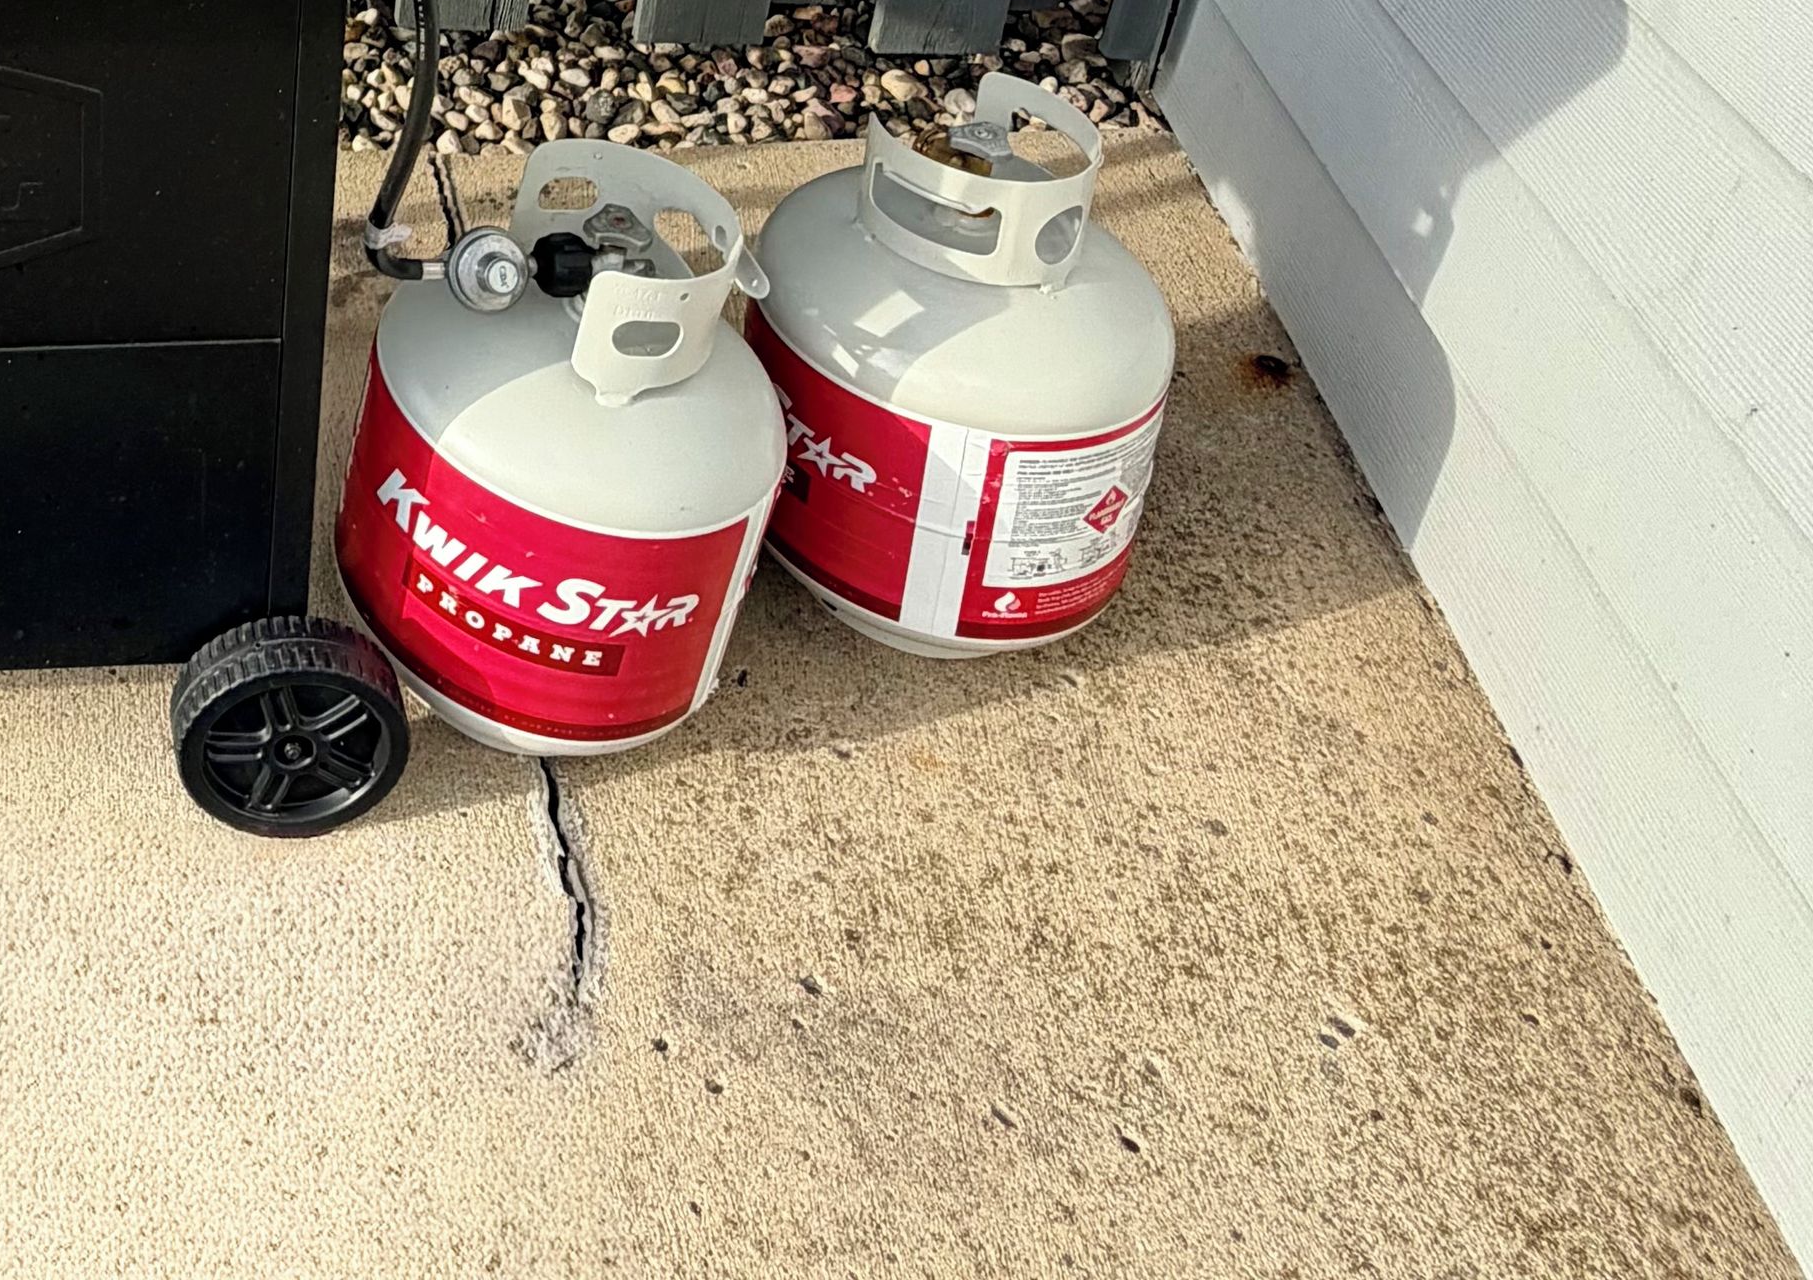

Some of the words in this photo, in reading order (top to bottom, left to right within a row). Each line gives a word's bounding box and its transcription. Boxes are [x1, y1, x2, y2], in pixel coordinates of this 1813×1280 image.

[376, 468, 544, 609] KWIK
[536, 577, 701, 638] STAR
[415, 573, 603, 667] PROPANE
